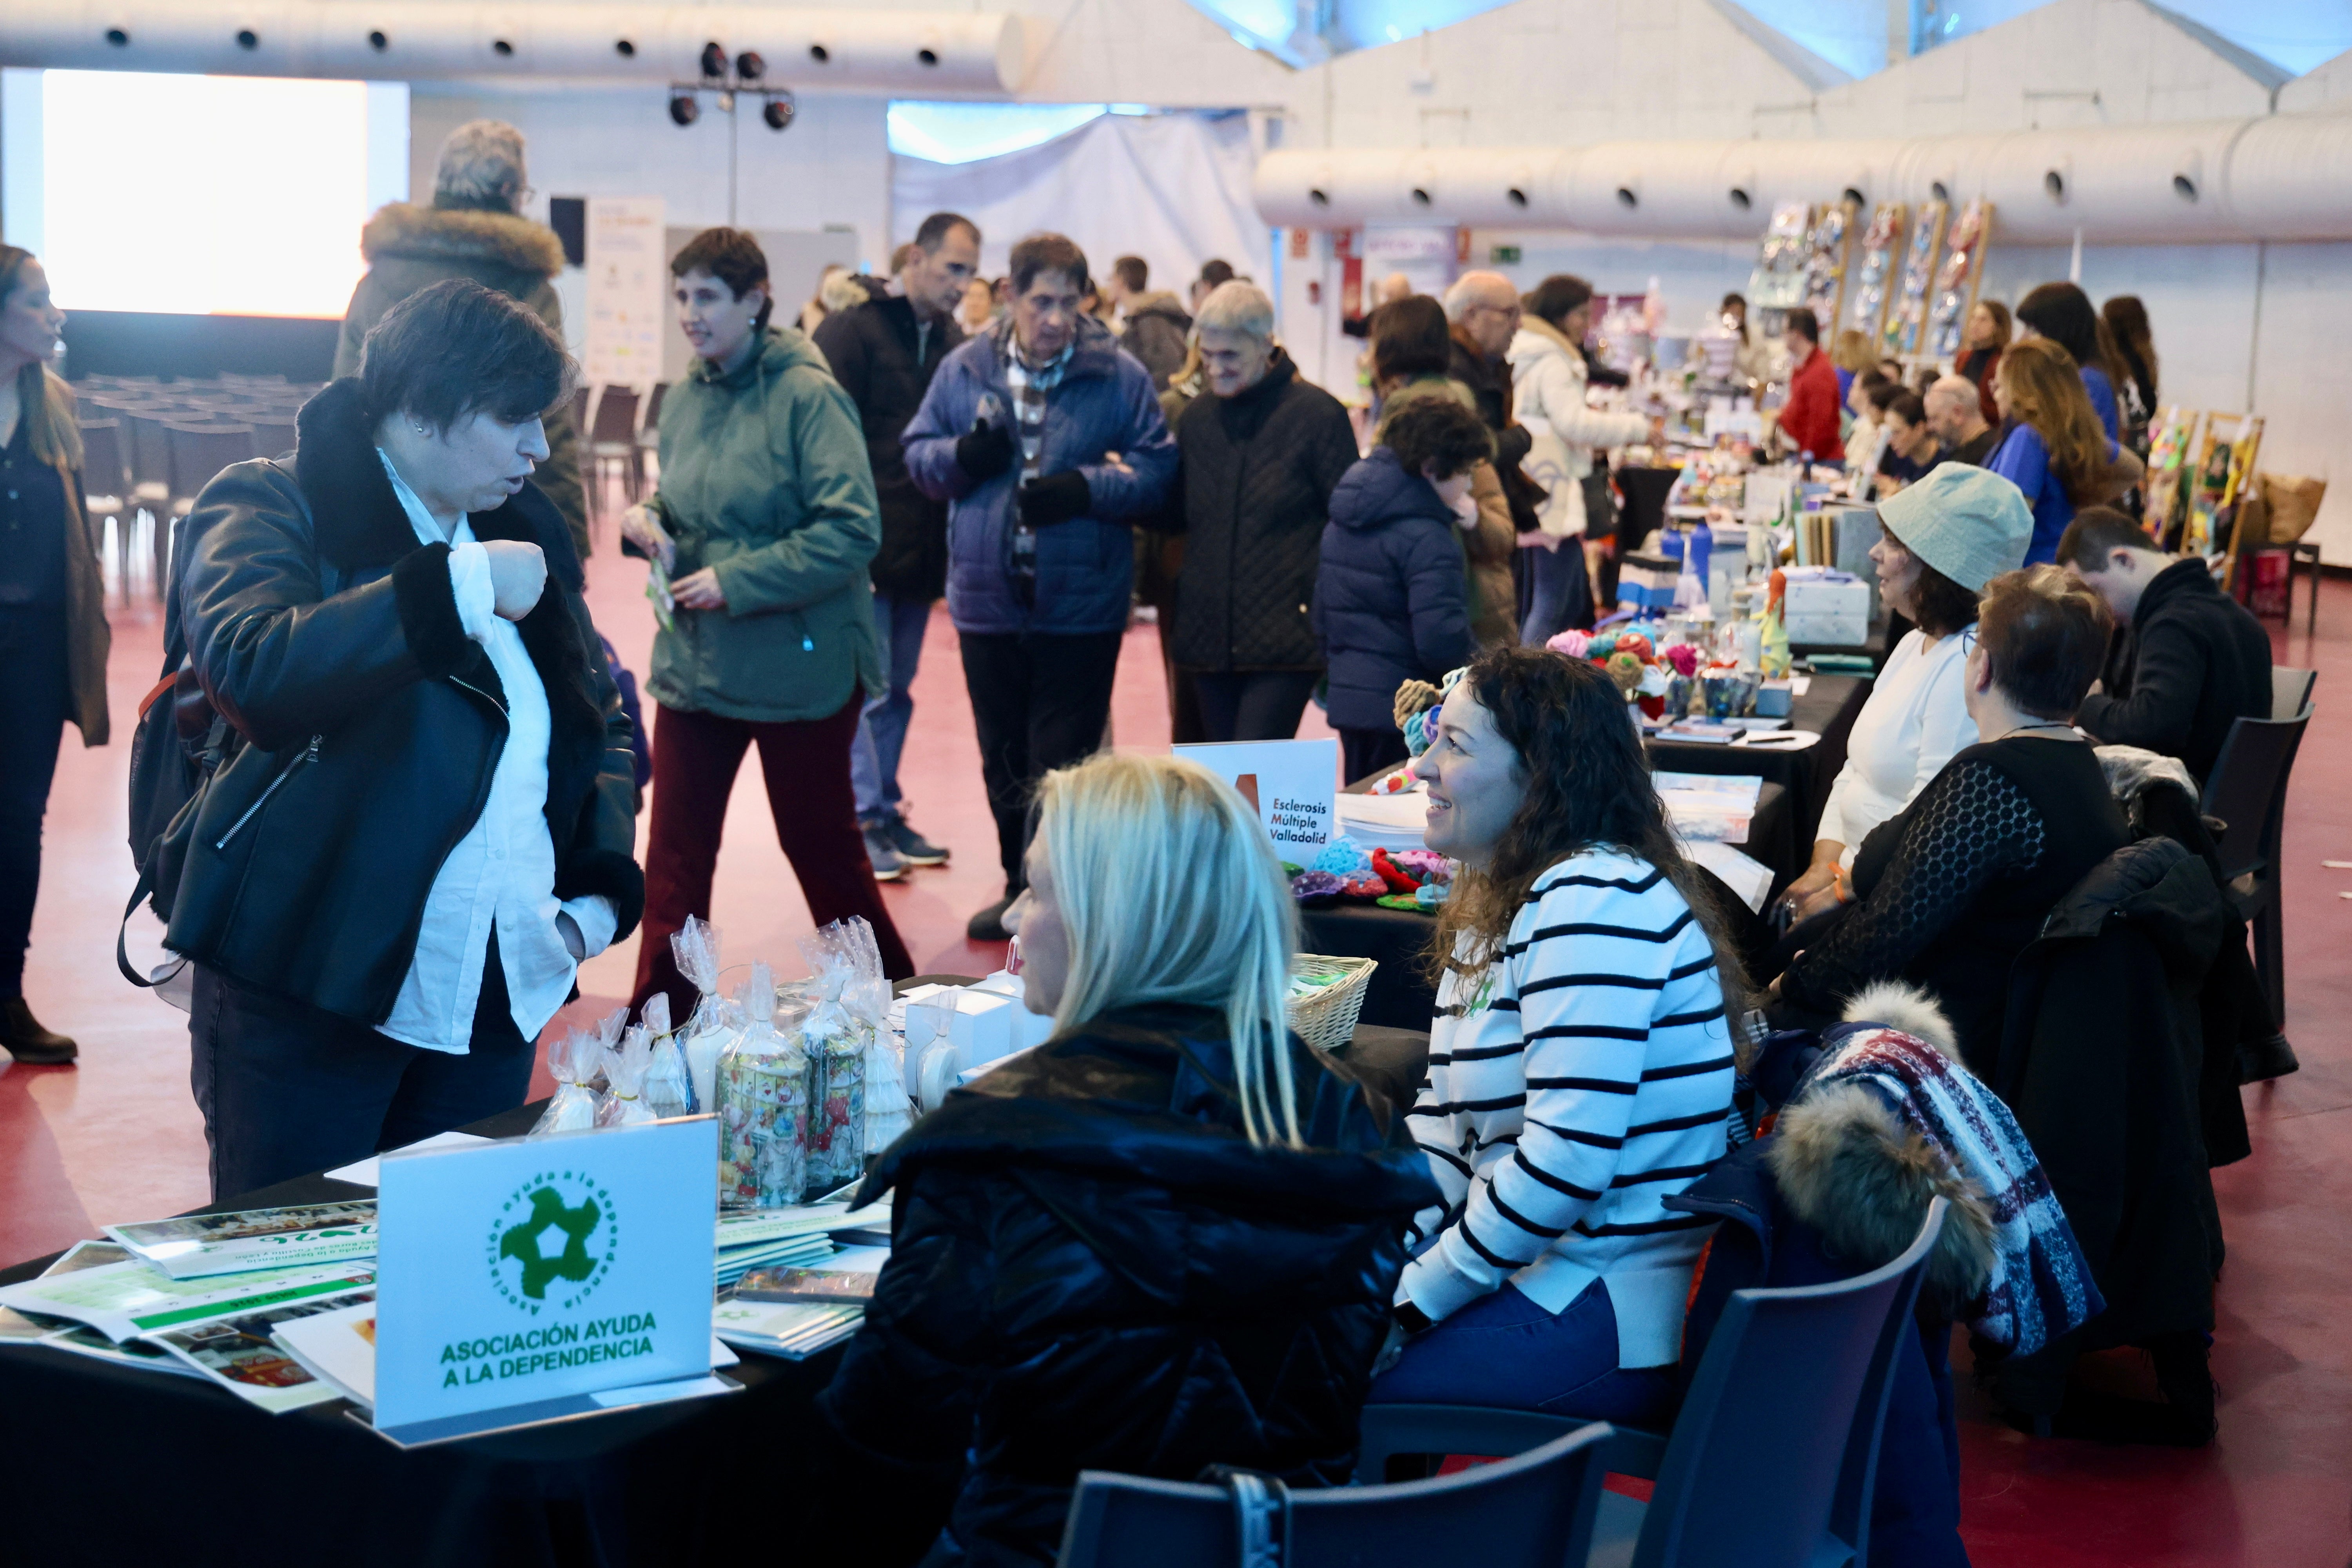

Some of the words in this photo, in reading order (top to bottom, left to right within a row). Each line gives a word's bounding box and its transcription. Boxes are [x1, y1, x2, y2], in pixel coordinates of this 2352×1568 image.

[1274, 798, 1326, 814] Esclerosis
[1271, 814, 1317, 830] Múltiple
[1270, 829, 1326, 844] Valladolid
[441, 1322, 579, 1364] ASOCIACIÓN
[584, 1312, 656, 1340] AYUDA
[443, 1368, 459, 1388] A
[465, 1363, 494, 1384] LA
[499, 1336, 653, 1379] DEPENDENCIA
